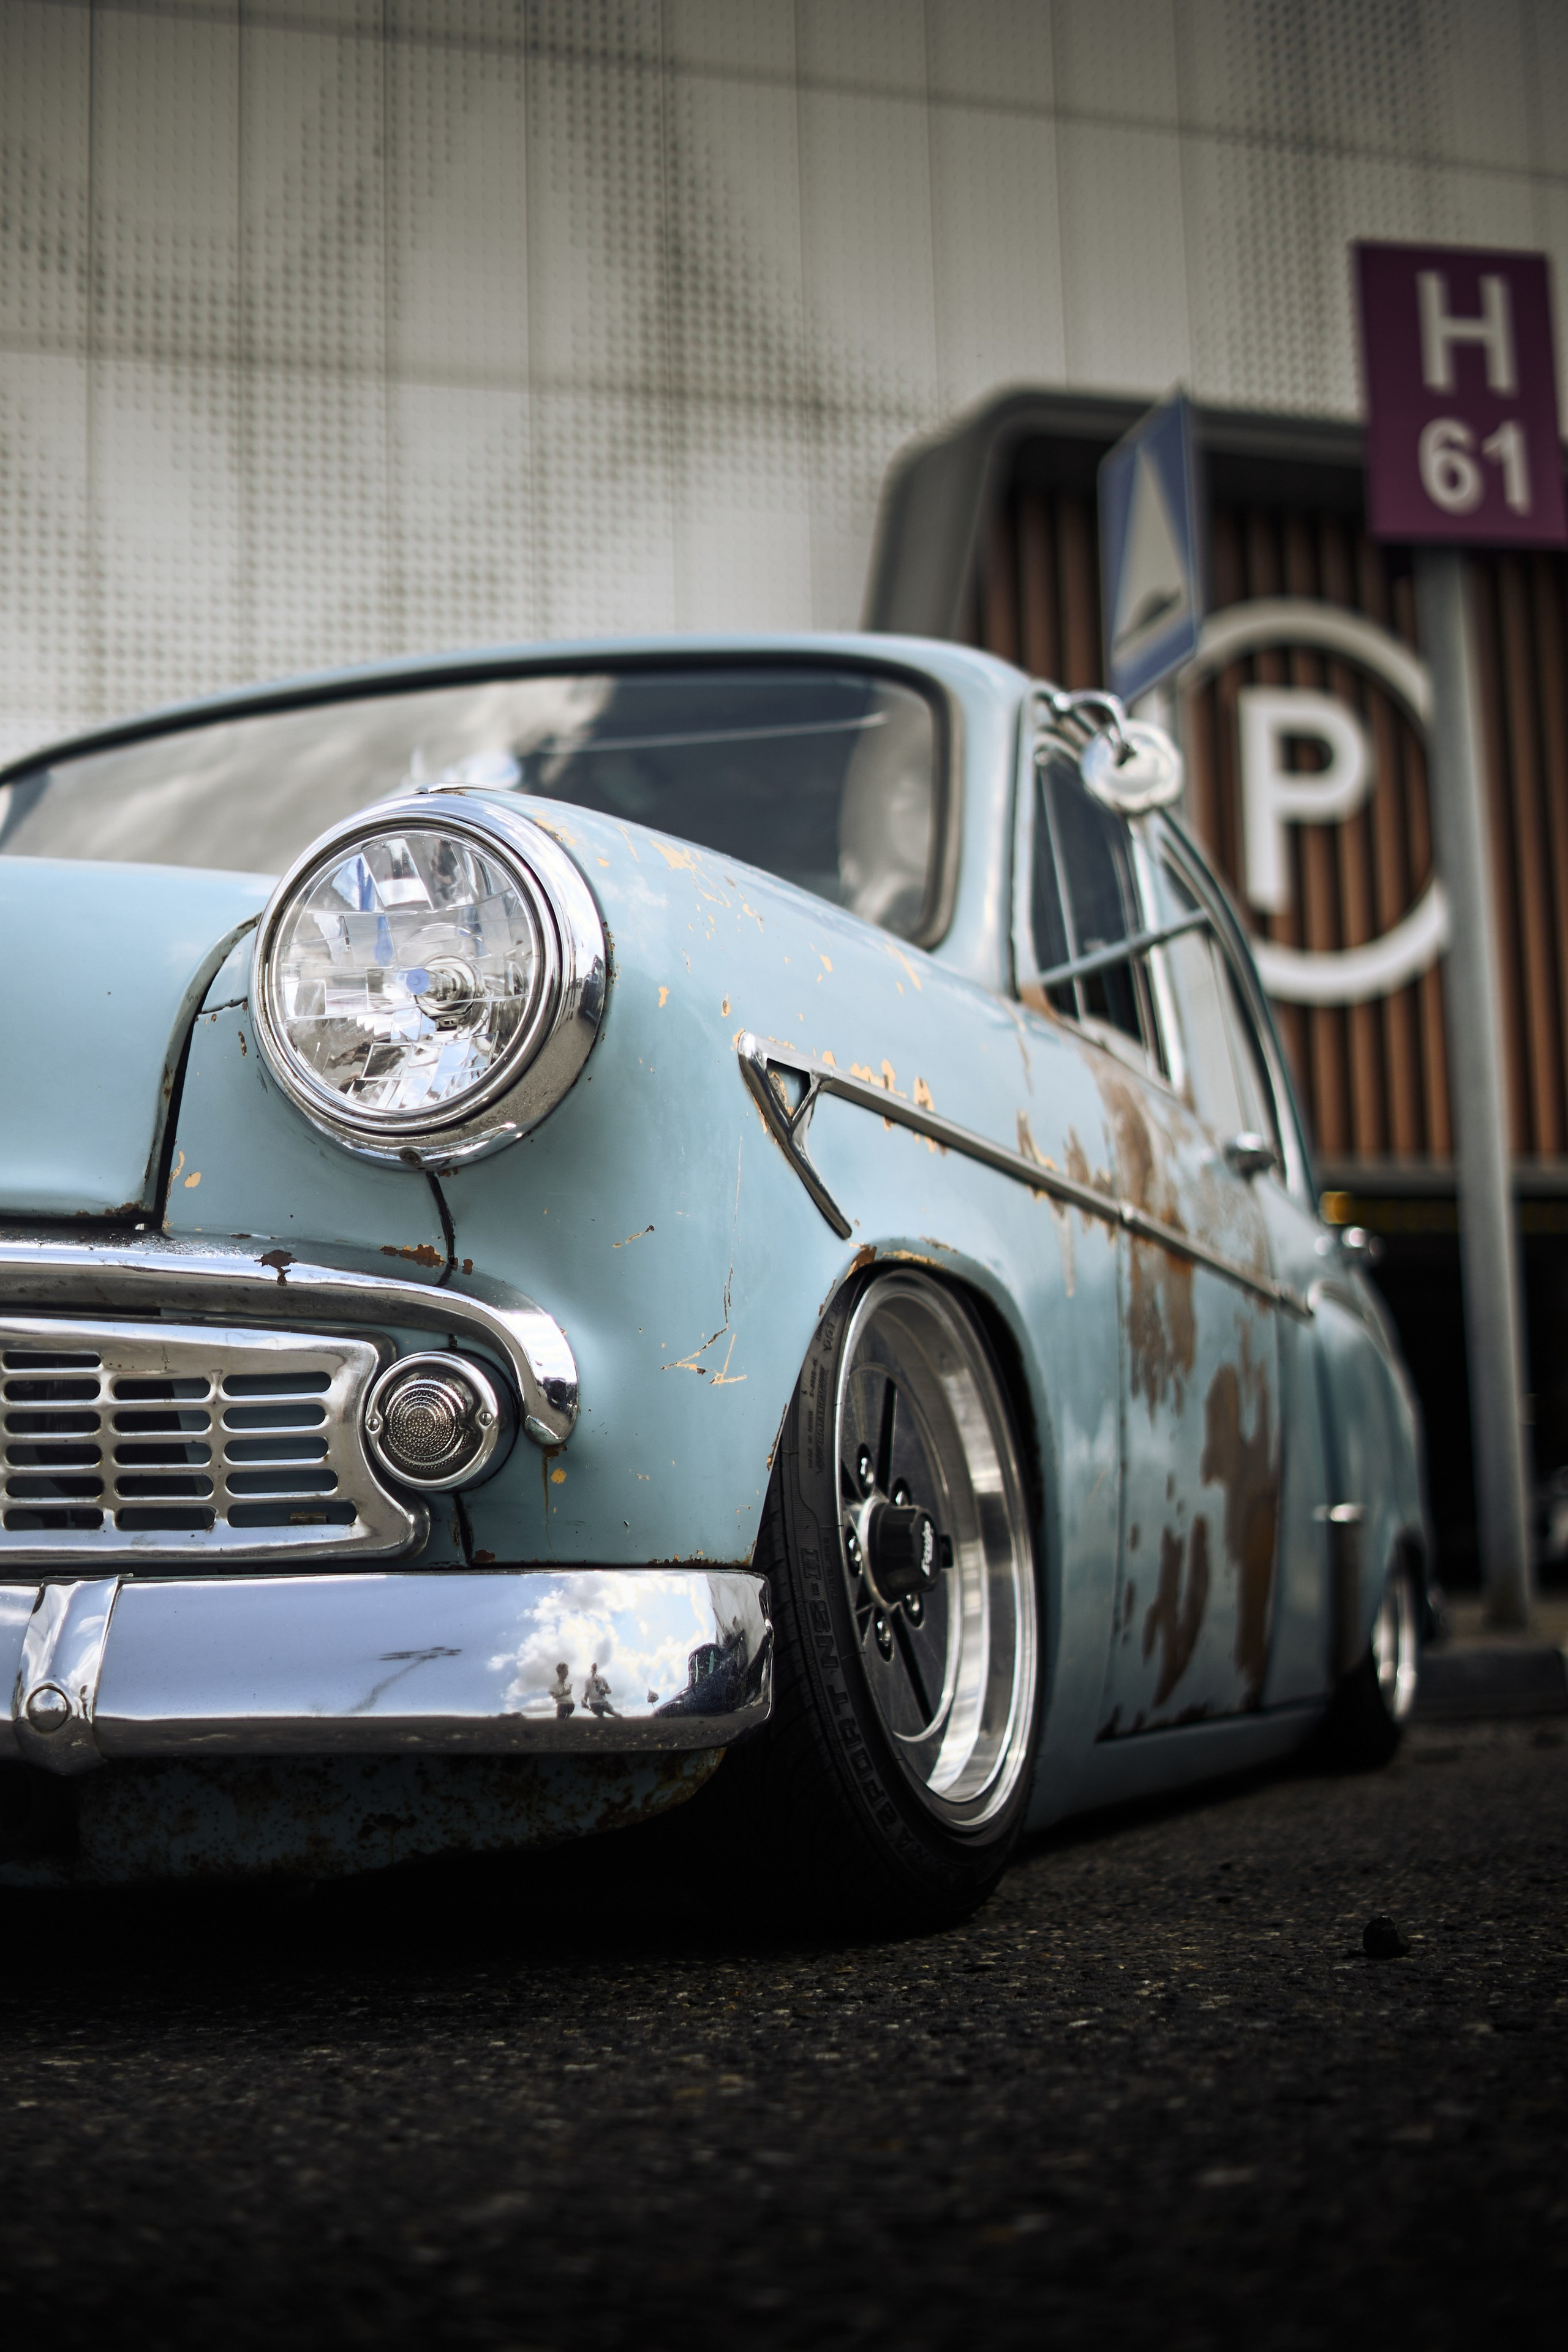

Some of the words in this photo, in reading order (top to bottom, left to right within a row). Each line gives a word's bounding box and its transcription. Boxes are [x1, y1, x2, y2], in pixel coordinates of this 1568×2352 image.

[1415, 270, 1517, 397] H
[1417, 417, 1530, 517] 61
[1238, 685, 1371, 915] P
[827, 1683, 898, 1832] SPORT
